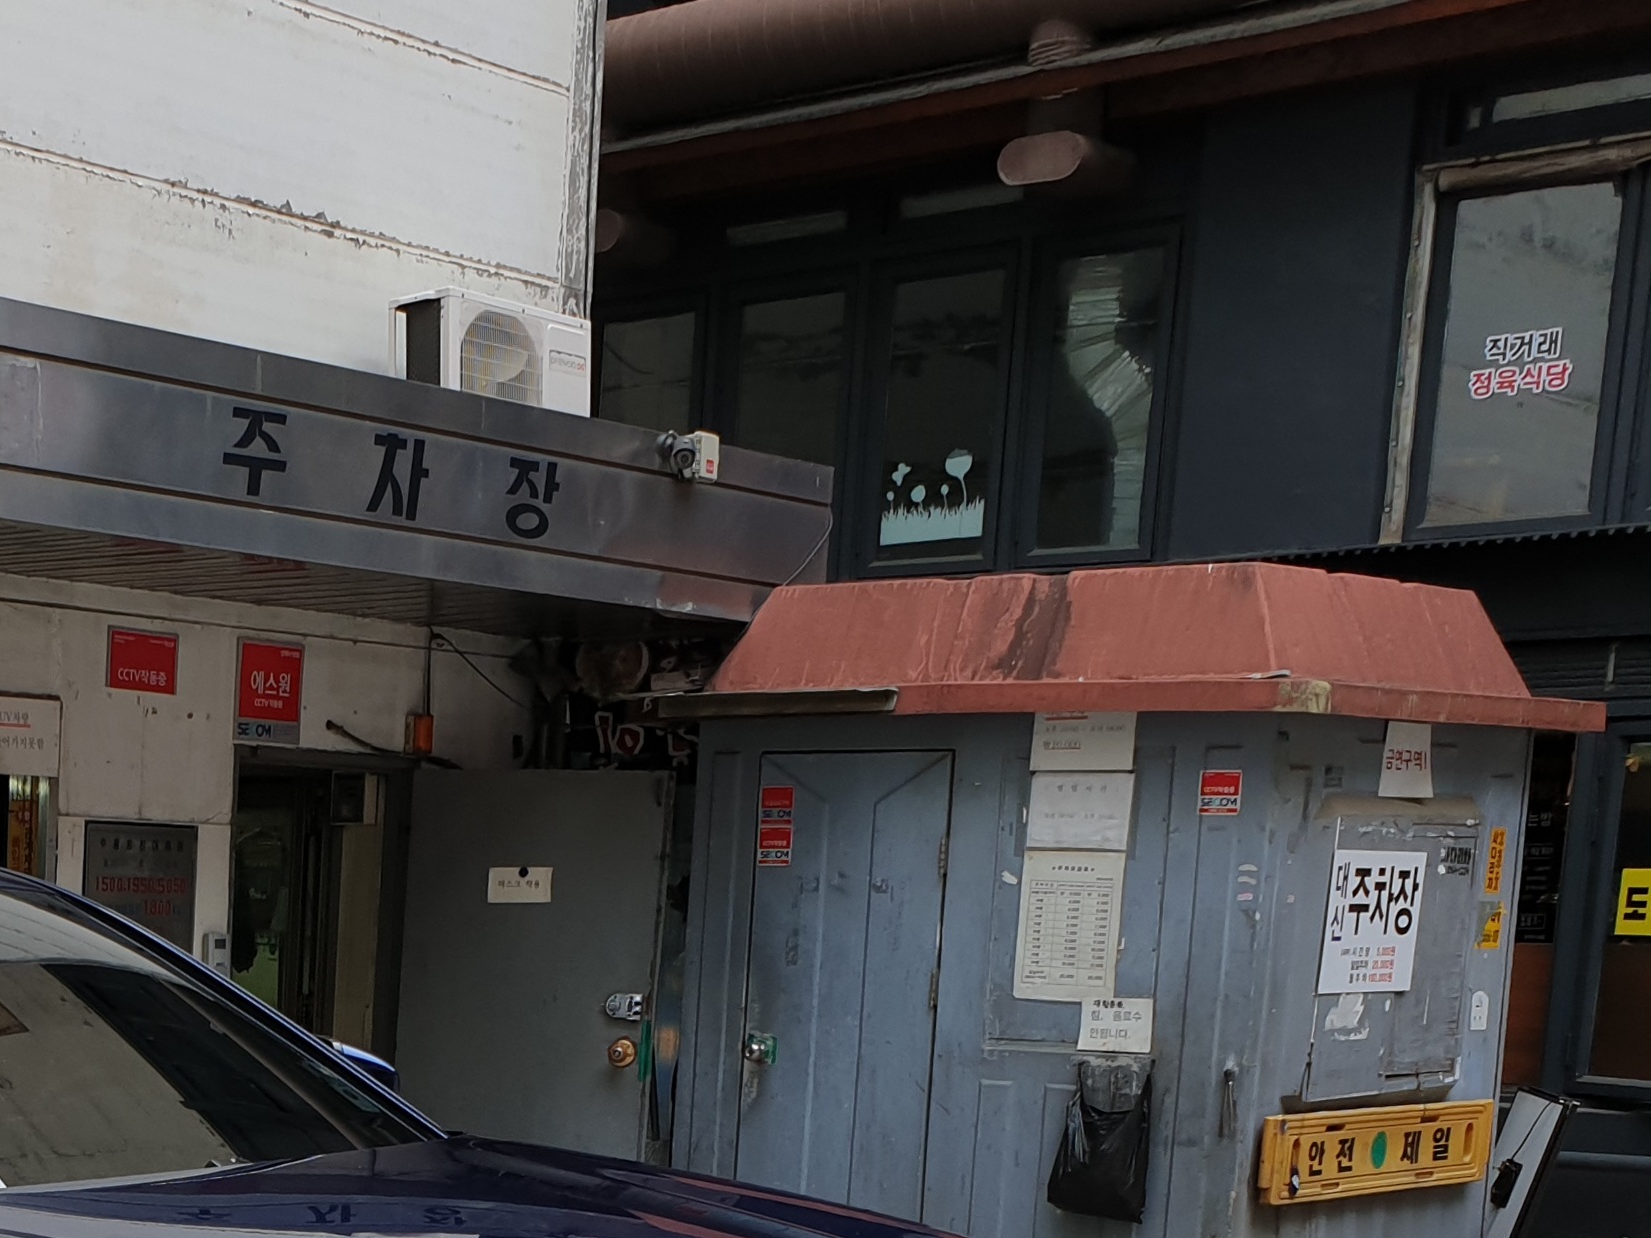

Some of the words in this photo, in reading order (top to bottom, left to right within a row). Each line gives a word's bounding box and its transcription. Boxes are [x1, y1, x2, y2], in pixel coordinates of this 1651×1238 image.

[1487, 329, 1562, 362] 직거래
[1470, 361, 1571, 398] 정육식당
[250, 669, 291, 698] 에스원
[237, 722, 272, 738] SEOM
[762, 809, 791, 819] SEOM
[760, 850, 789, 859] SEOM
[1348, 865, 1420, 935] 주차장
[1623, 886, 1650, 921] 도
